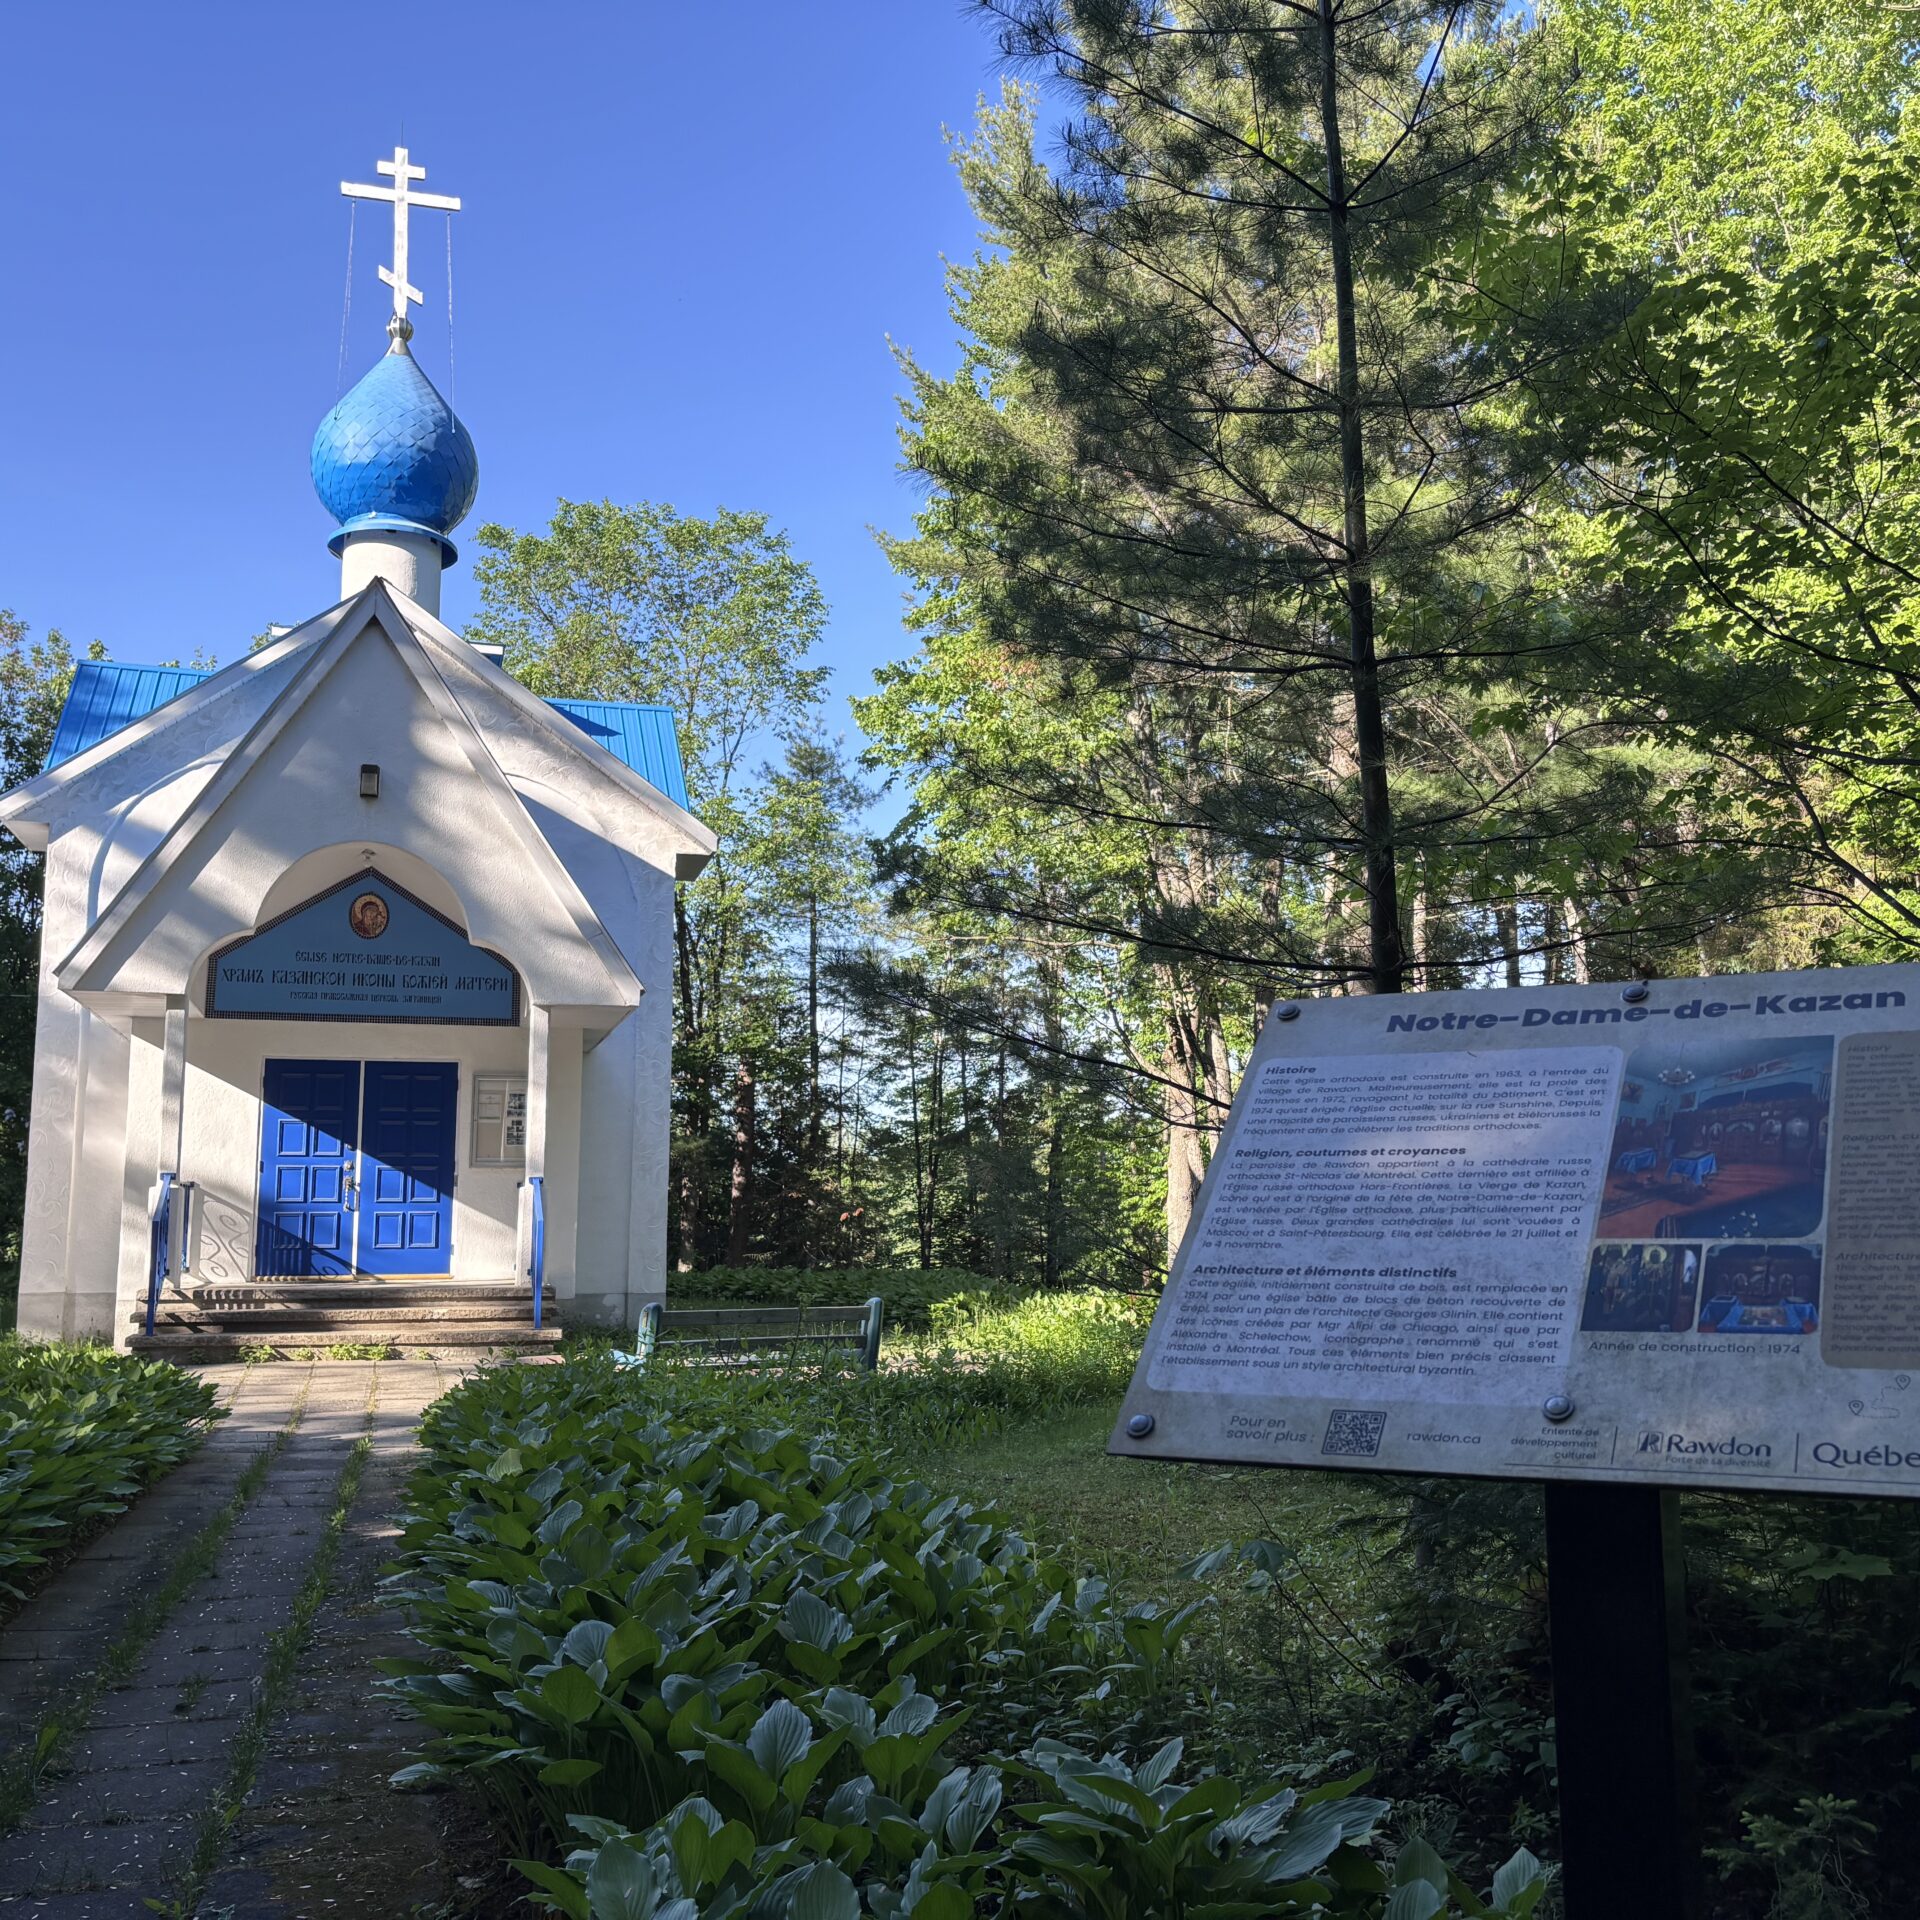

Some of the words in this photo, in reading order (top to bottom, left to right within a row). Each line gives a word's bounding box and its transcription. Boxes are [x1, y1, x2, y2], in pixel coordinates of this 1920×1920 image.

[295, 950, 327, 963] ÉGLISE
[352, 972, 395, 988] ИКОНЫ
[454, 975, 508, 991] МАТЕРИ
[1386, 991, 1906, 1032] Notre-Dame-de-Kazan
[1265, 1065, 1317, 1074] Histoire
[1332, 1114, 1397, 1124] paroissiens
[1440, 1111, 1501, 1120] ukrainiens
[1396, 1124, 1413, 1132] les
[1415, 1123, 1471, 1131] traditions
[1295, 1147, 1368, 1157] coutumes
[1370, 1146, 1386, 1156] et
[1387, 1147, 1467, 1157] croyances
[1248, 1161, 1296, 1170] paroisse
[1324, 1160, 1371, 1168] Rawdon
[1377, 1159, 1440, 1169] appartient
[1227, 1172, 1282, 1180] orthodoxe
[1284, 1171, 1342, 1179] St-Nicolas
[1420, 1170, 1454, 1178] Cette
[1511, 1169, 1531, 1177] est
[1297, 1182, 1355, 1190] orthodoxe
[1478, 1181, 1518, 1190] Vierge
[1206, 1228, 1250, 1236] Moscou
[1391, 1228, 1411, 1237] Elle
[1414, 1228, 1434, 1237] est
[1526, 1229, 1561, 1239] juillet
[1193, 1264, 1284, 1275] Architecture
[1286, 1265, 1302, 1275] et
[1303, 1265, 1376, 1276] éléments
[1378, 1266, 1457, 1277] distinctifs
[1183, 1291, 1209, 1300] 1974
[1212, 1293, 1234, 1302] par
[1364, 1294, 1398, 1303] blocs
[1470, 1297, 1542, 1306] recouverte
[1212, 1304, 1245, 1313] selon
[1263, 1305, 1292, 1316] plan
[1384, 1308, 1438, 1319] Georges
[1482, 1310, 1505, 1319] Elle
[1507, 1311, 1563, 1321] contient
[1174, 1316, 1197, 1325] des
[1289, 1321, 1312, 1330] par
[1317, 1319, 1341, 1331] Mgr
[1347, 1320, 1374, 1332] Alipi
[1466, 1323, 1498, 1333] ainsi
[1503, 1326, 1530, 1335] que
[1536, 1327, 1560, 1336] par
[1170, 1329, 1228, 1339] Alexandre
[1324, 1333, 1405, 1346] iconographe
[1492, 1338, 1515, 1349] qui
[1588, 1341, 1635, 1351] Année
[1639, 1342, 1657, 1351] de
[1661, 1342, 1756, 1353] construction
[1767, 1343, 1801, 1354] 1974
[1287, 1346, 1317, 1355] Tous
[1416, 1349, 1445, 1359] bien
[1498, 1352, 1556, 1363] classent
[1252, 1360, 1281, 1368] sous
[1301, 1360, 1331, 1371] style
[1333, 1361, 1416, 1373] architectural
[1230, 1415, 1264, 1427] Pour
[1267, 1419, 1286, 1428] en
[1226, 1428, 1272, 1440] savoir
[1274, 1430, 1307, 1444] plus
[1406, 1431, 1481, 1445] rawdon.ca
[1541, 1427, 1582, 1436] Entente
[1584, 1427, 1600, 1437] de
[1510, 1437, 1598, 1449] développement
[1667, 1433, 1771, 1457] Rawdon
[1554, 1451, 1596, 1461] culturel
[1665, 1456, 1691, 1464] Forte
[1695, 1456, 1708, 1465] de
[1813, 1442, 1920, 1468] Québe
